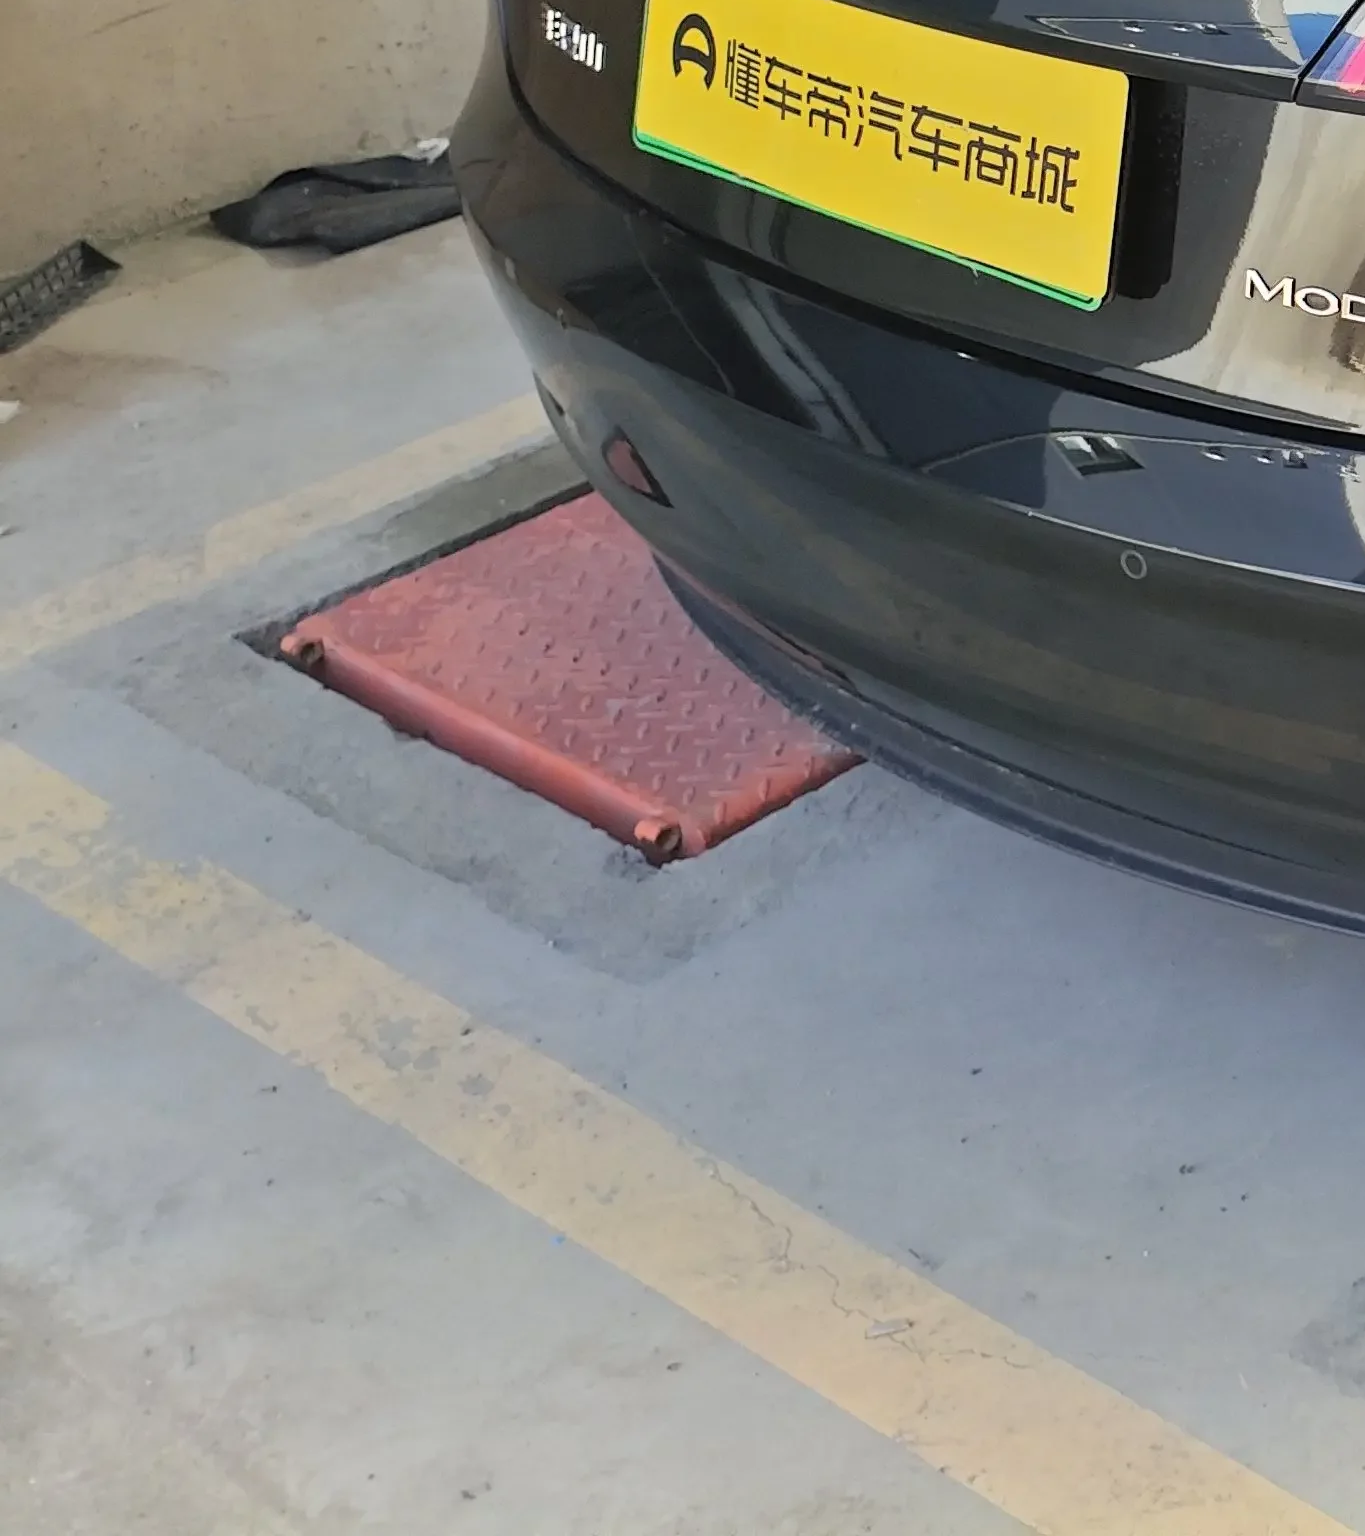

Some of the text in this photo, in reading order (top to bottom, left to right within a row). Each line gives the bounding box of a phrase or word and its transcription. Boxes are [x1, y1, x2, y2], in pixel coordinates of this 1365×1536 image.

[724, 38, 1081, 214] 懂车帝汽车商城
